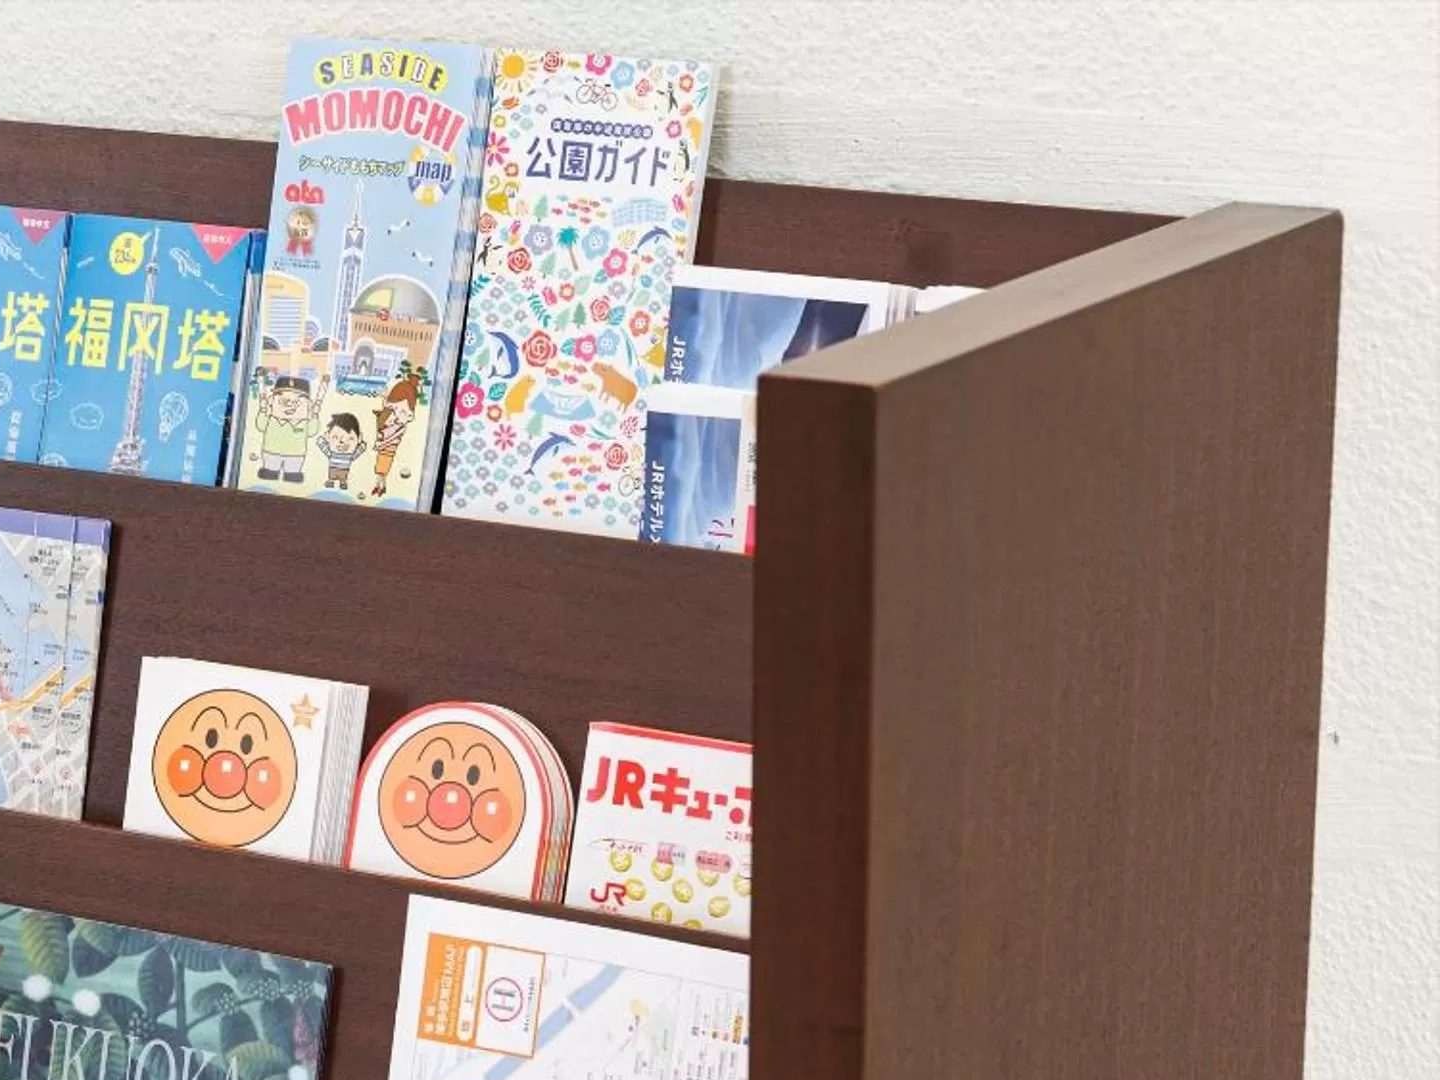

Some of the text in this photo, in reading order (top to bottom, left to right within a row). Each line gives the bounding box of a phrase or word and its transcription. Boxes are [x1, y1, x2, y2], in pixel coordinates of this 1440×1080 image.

[318, 50, 445, 92] SEASIDE
[284, 89, 467, 153] MOMOCHI
[415, 160, 453, 183] map
[526, 136, 671, 187] 公園ガイド
[64, 296, 231, 381] 福冈塔
[669, 334, 688, 385] JRホ
[590, 881, 626, 907] JR
